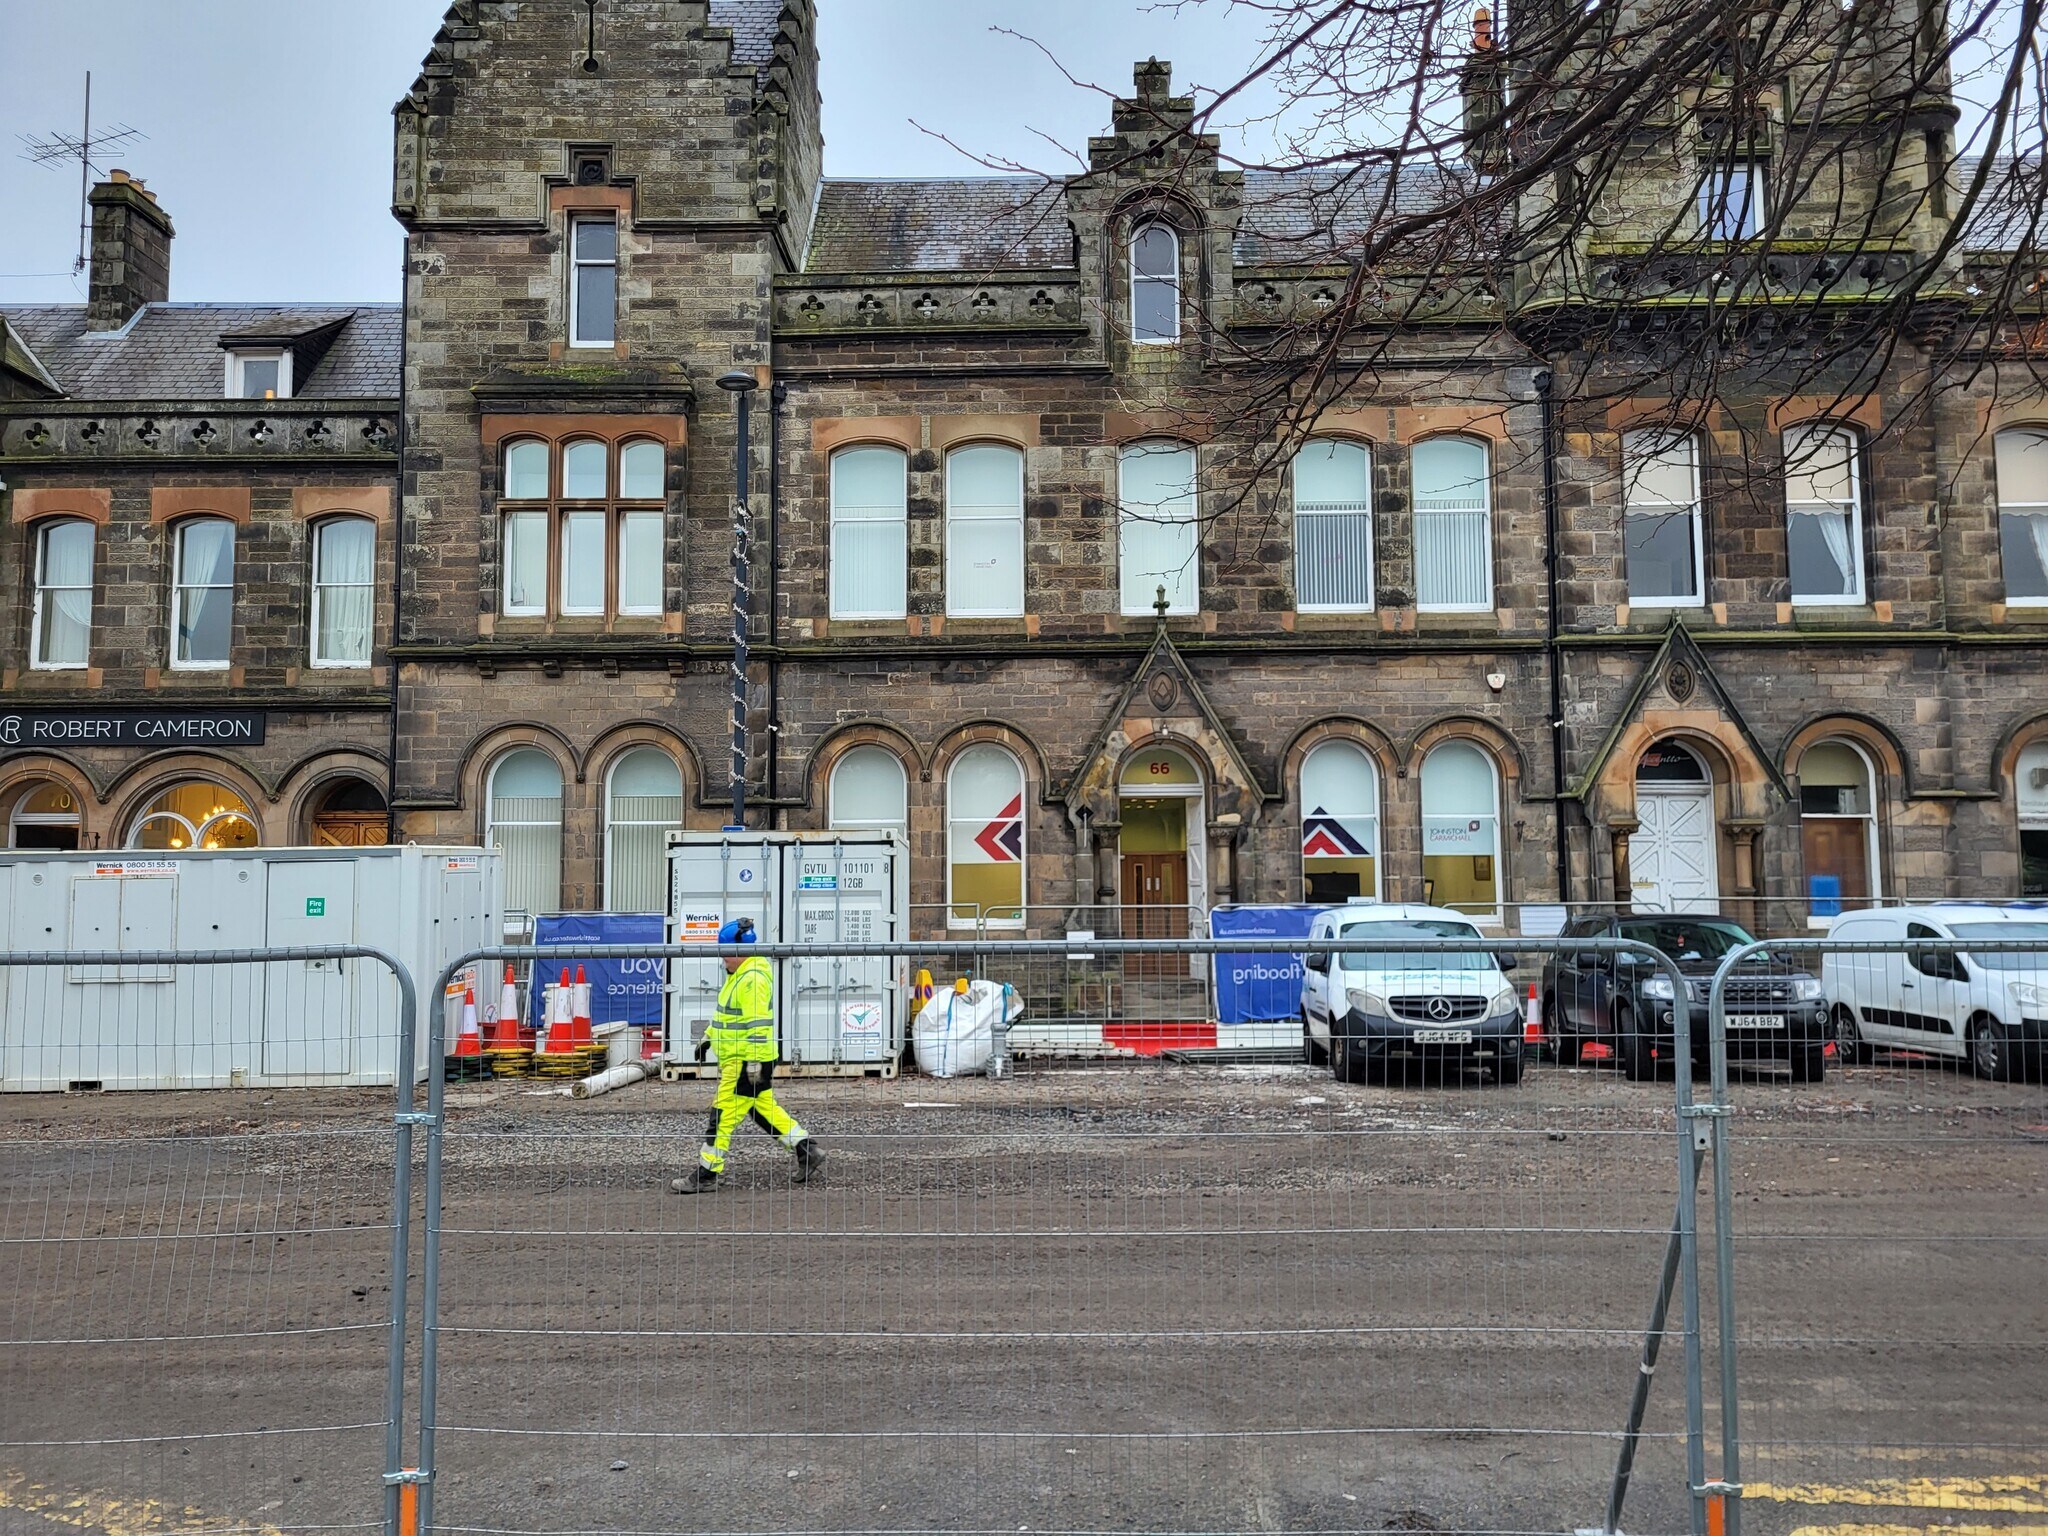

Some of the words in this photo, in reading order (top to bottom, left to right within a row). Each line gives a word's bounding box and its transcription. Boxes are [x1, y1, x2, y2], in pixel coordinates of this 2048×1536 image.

[33, 720, 126, 738] ROBERT
[135, 719, 251, 738] CAMERON
[1150, 762, 1170, 775] 66
[804, 863, 827, 874] GVTU
[844, 863, 874, 873] 101101
[884, 863, 889, 873] 8
